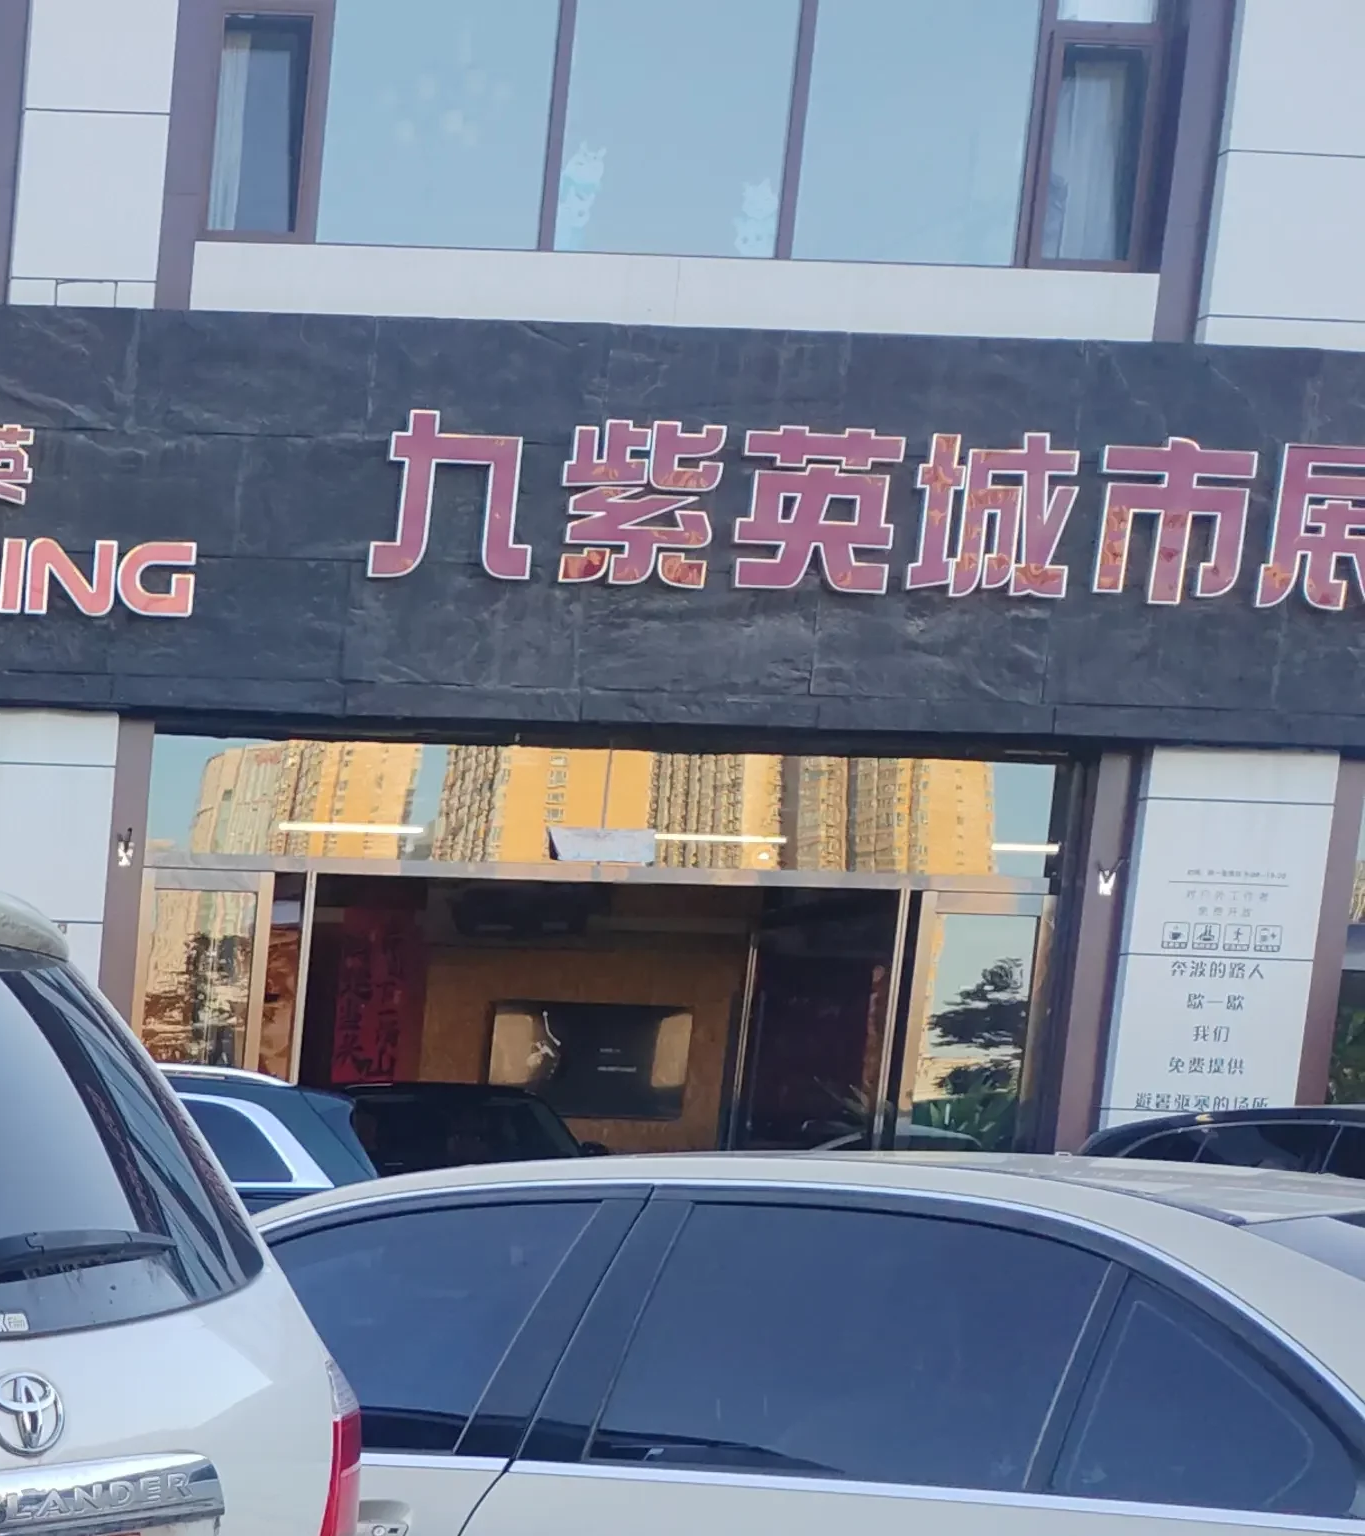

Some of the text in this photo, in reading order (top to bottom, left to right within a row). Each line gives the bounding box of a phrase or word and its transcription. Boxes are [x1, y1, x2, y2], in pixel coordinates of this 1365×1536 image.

[1171, 960, 1265, 980] 奔波的路人
[1187, 993, 1245, 1012] 歇一歇
[1193, 1025, 1231, 1043] 我们
[1168, 1057, 1245, 1075] 免费提供
